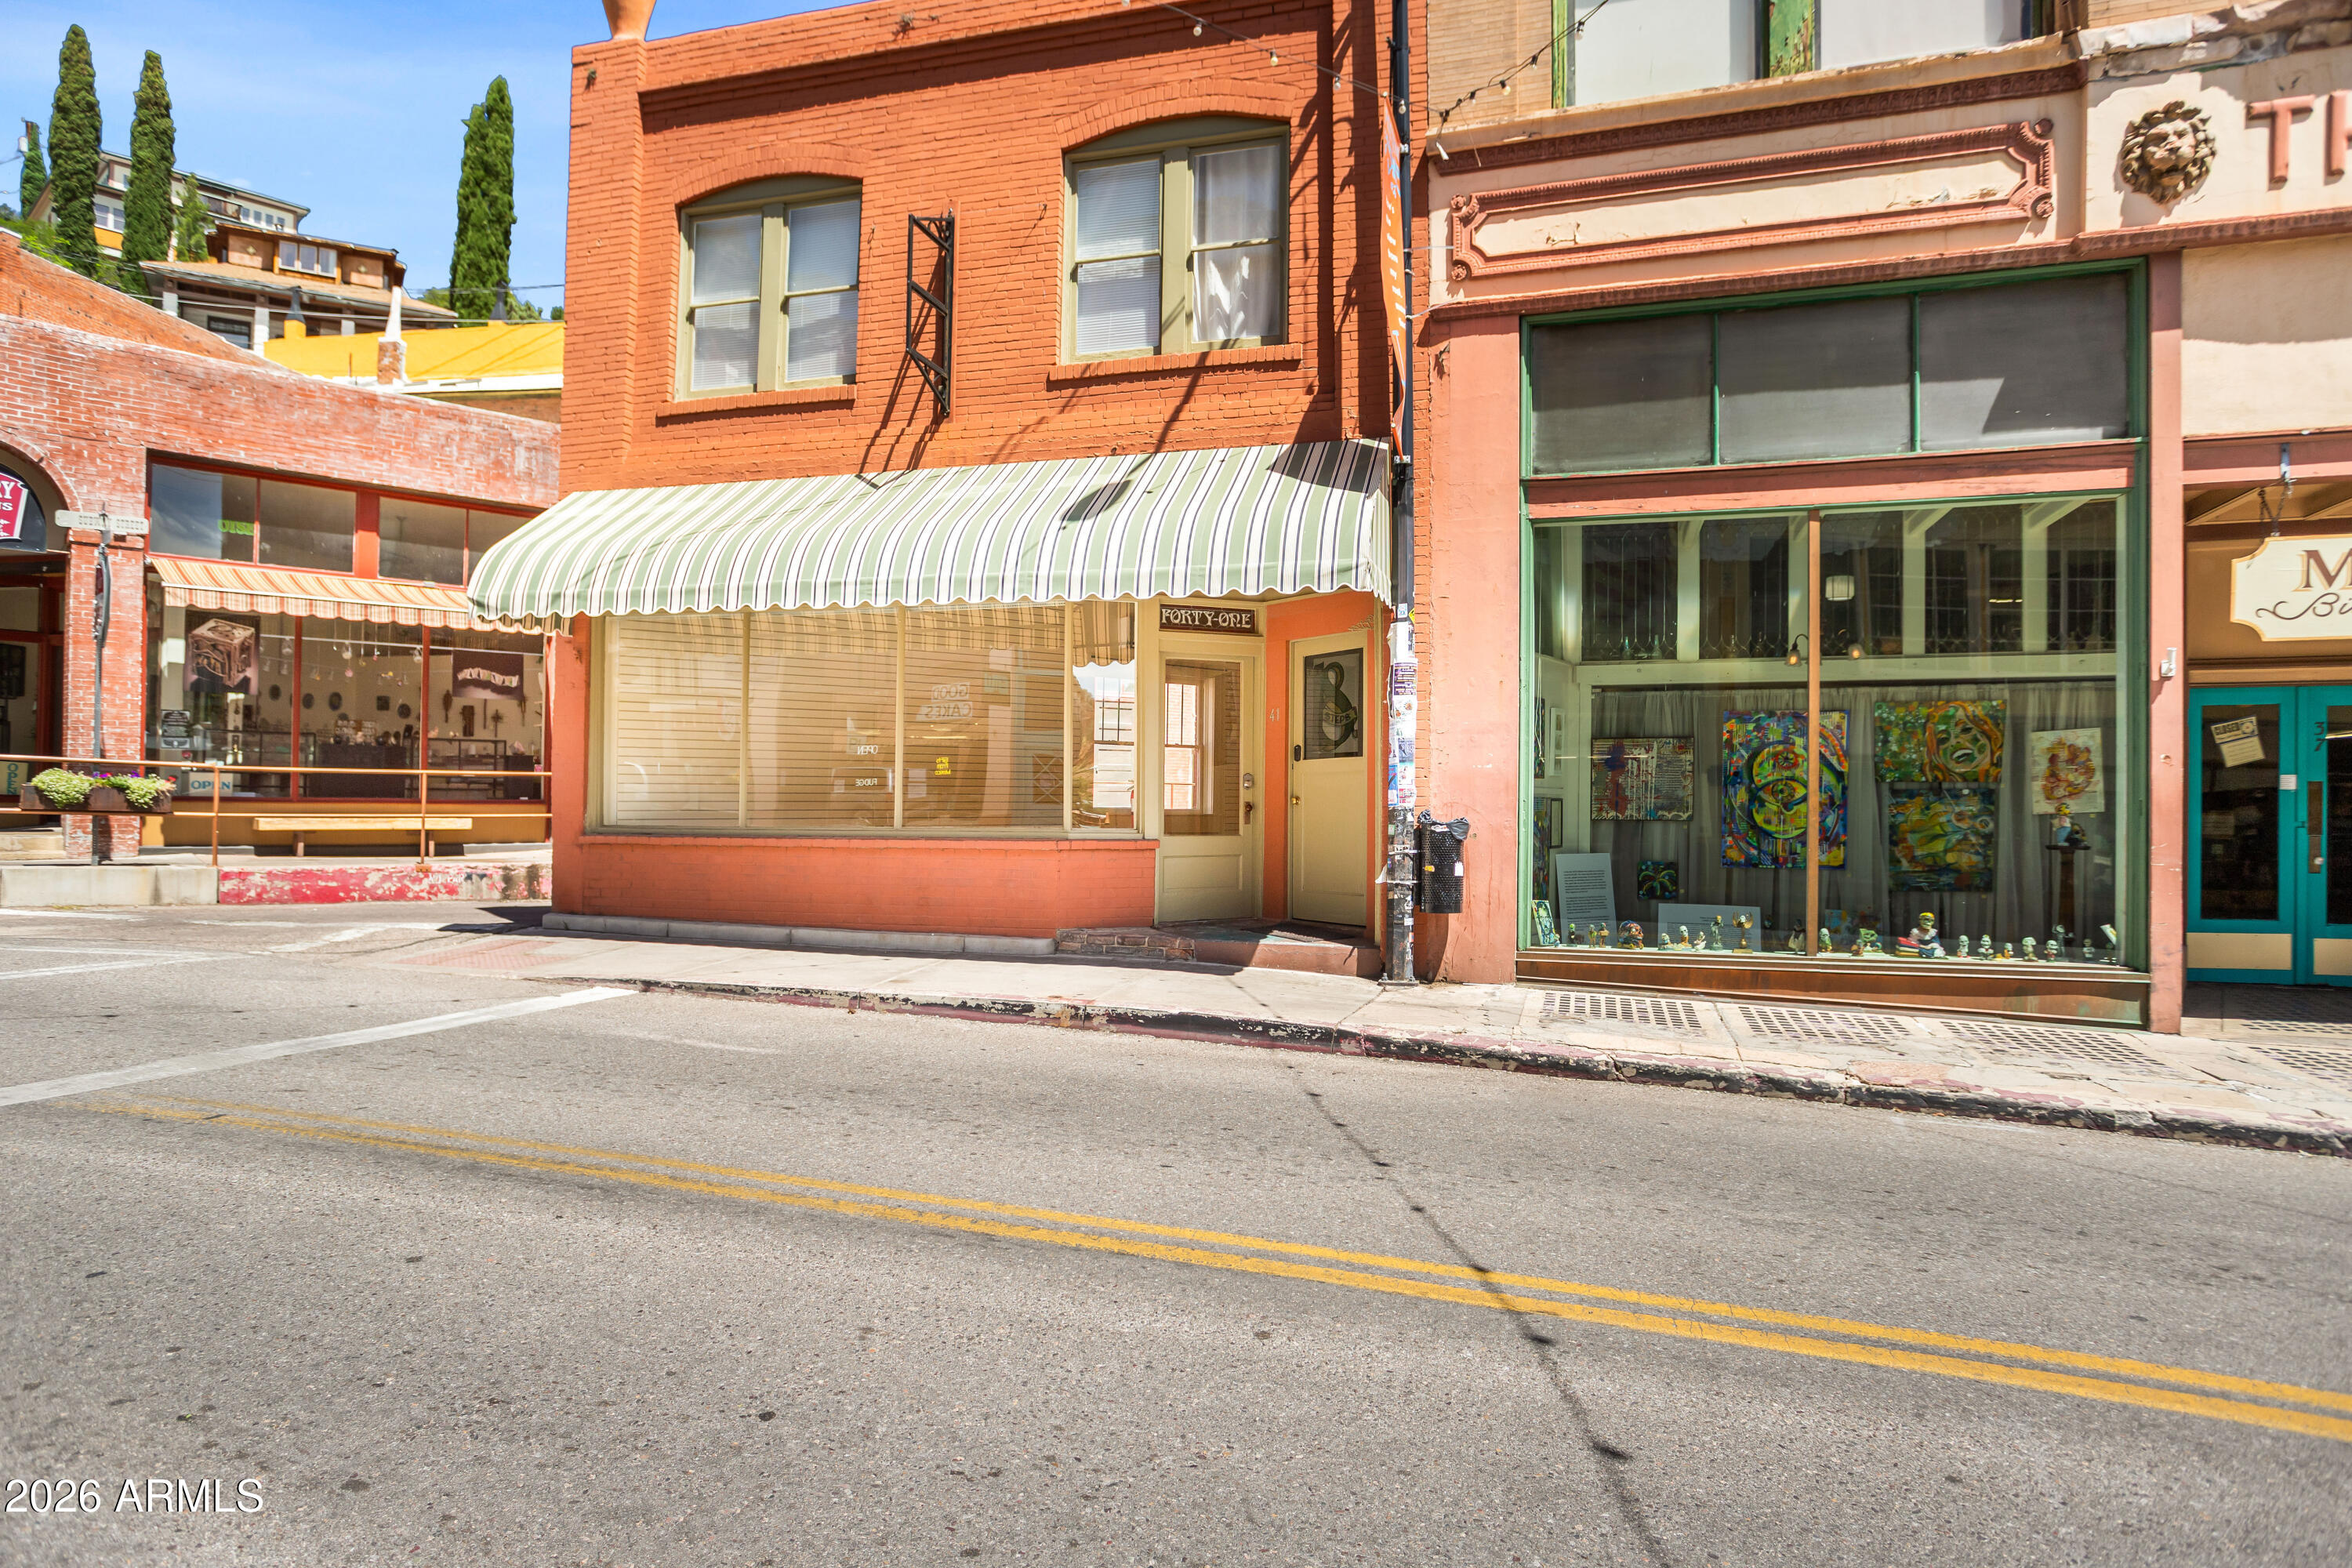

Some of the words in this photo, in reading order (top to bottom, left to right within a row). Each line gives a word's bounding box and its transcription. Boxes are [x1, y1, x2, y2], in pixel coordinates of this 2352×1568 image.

[1161, 608, 1251, 628] FORTY-ONE
[1269, 707, 1280, 722] 41
[191, 780, 230, 789] OPN
